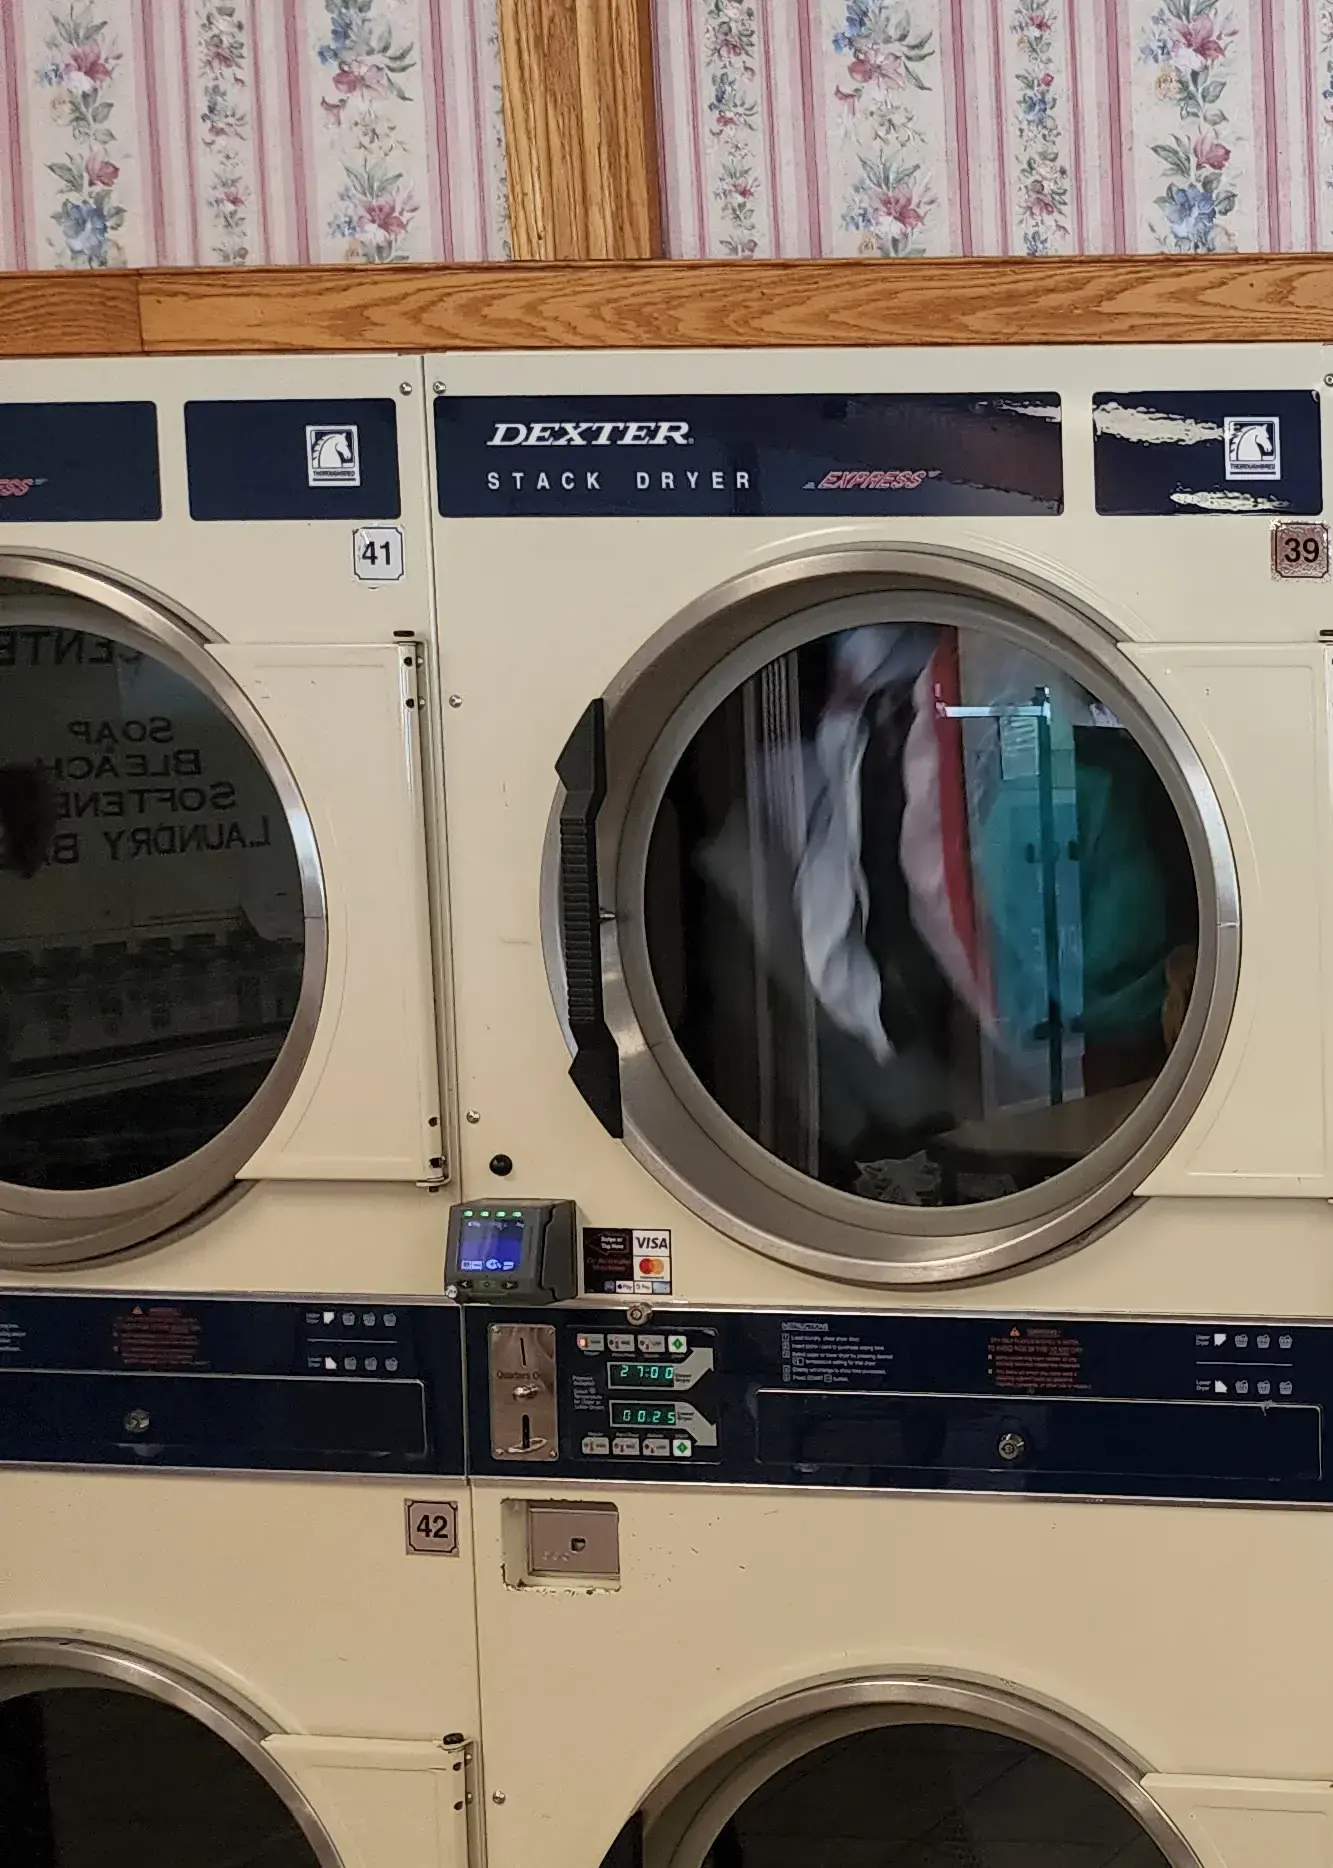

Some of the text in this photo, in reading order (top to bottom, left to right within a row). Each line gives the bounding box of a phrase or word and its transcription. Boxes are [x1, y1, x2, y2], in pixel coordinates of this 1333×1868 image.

[486, 422, 692, 446] DEXTER
[487, 471, 751, 490] STACK DRYER
[817, 470, 929, 490] EXPRESS
[361, 541, 392, 566] 41
[1284, 537, 1320, 563] 39
[634, 1236, 669, 1250] VISA
[416, 1515, 449, 1539] 42
